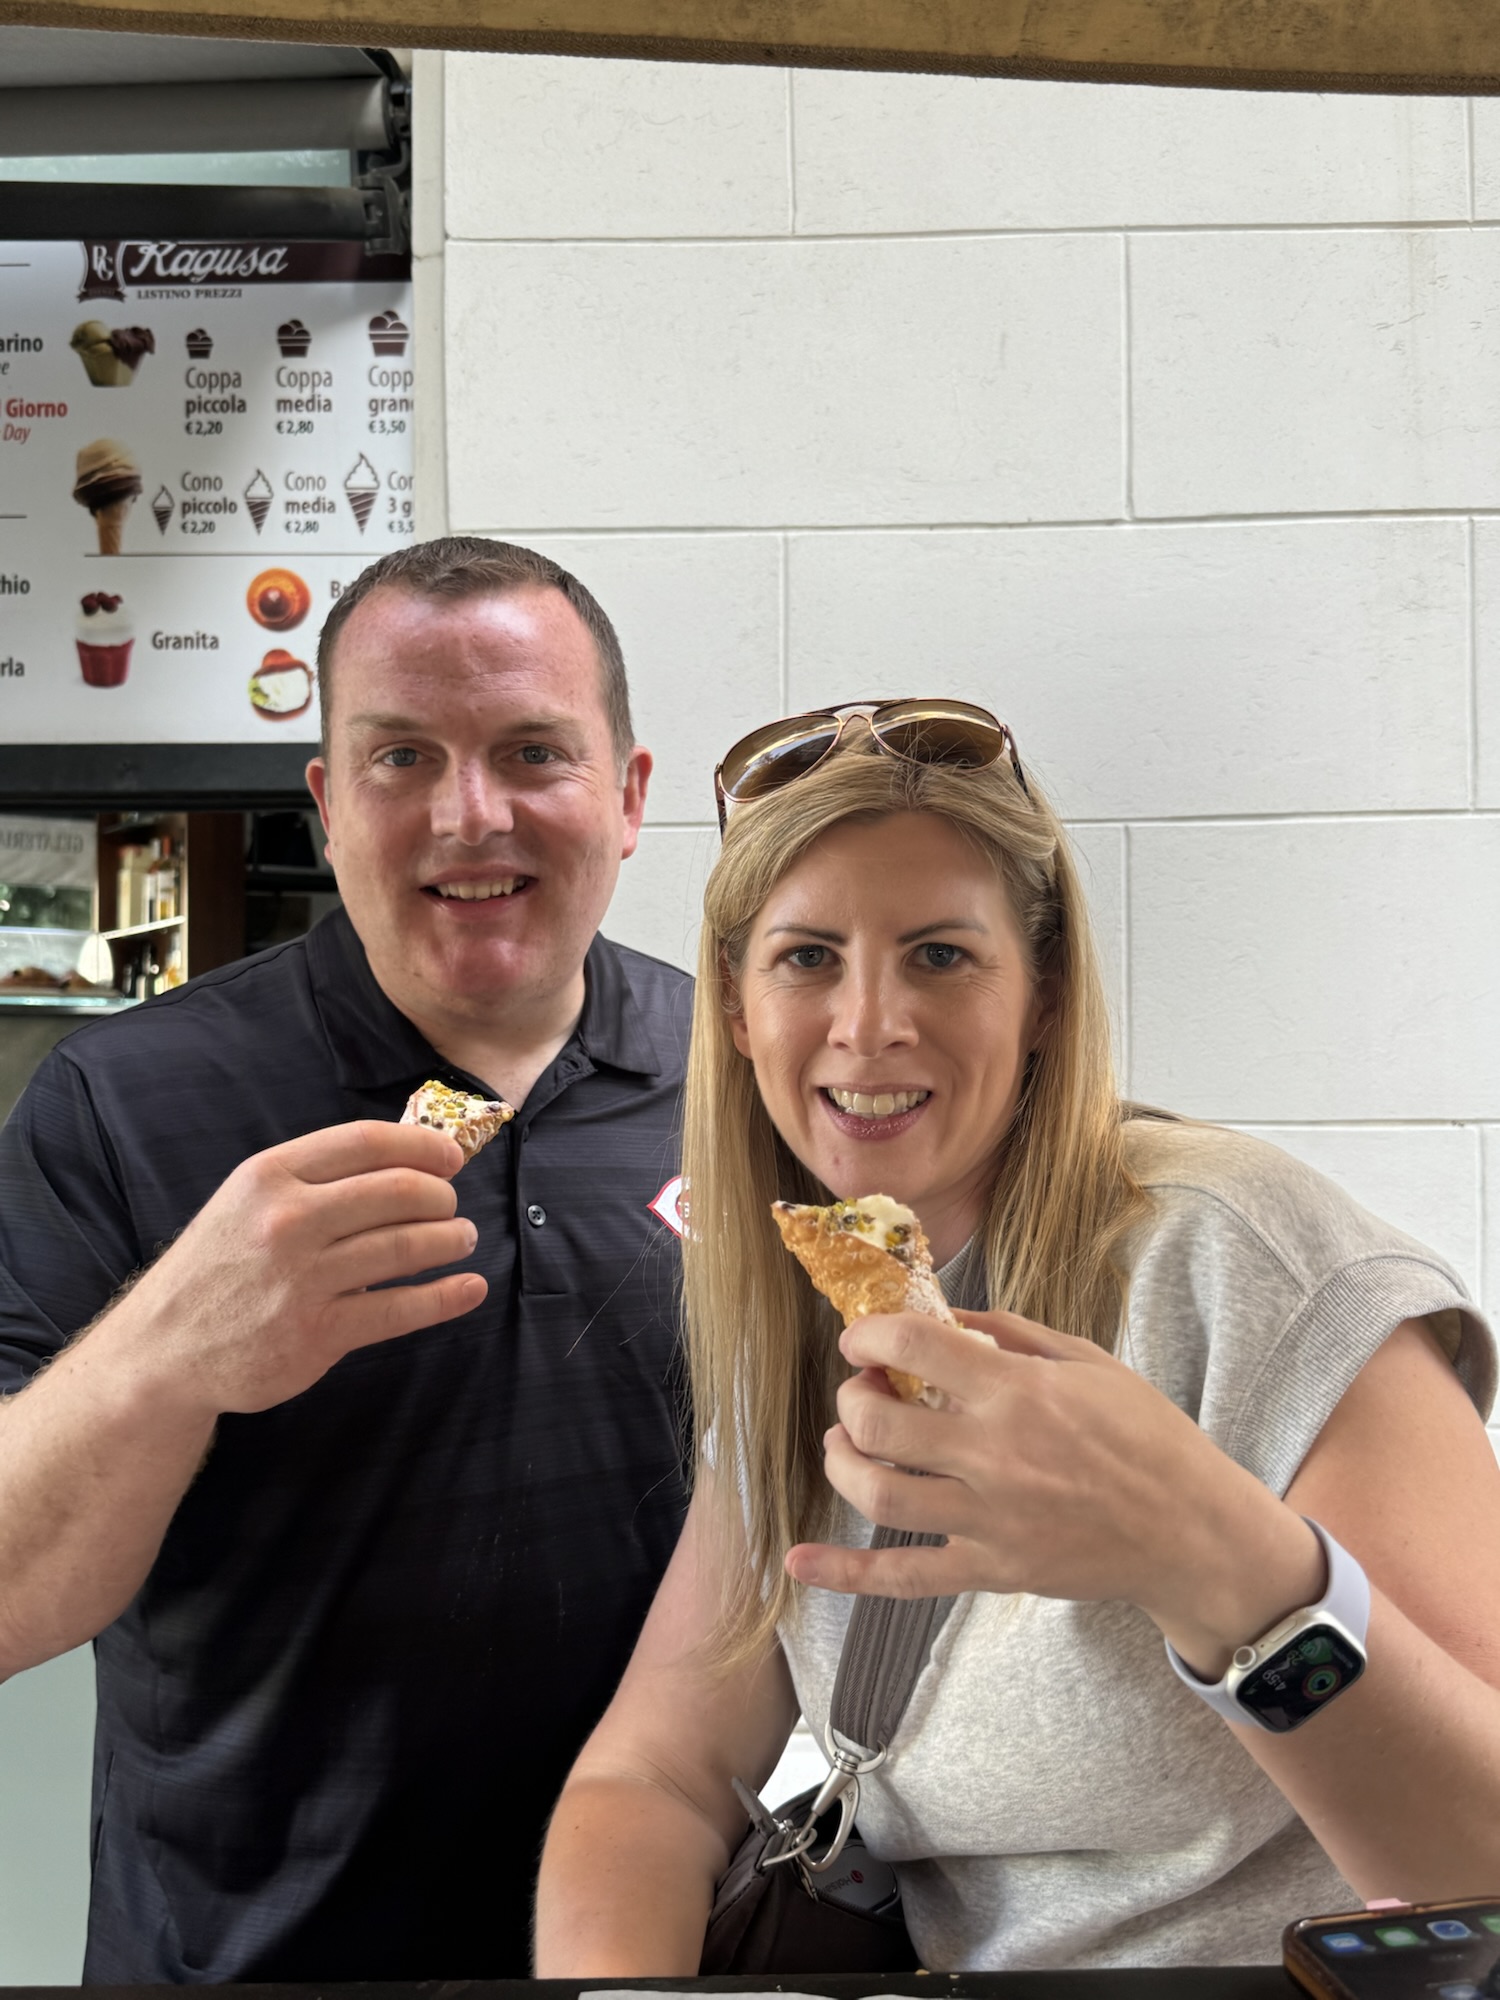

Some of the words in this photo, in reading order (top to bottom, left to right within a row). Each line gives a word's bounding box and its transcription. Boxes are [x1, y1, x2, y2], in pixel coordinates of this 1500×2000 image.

[137, 289, 191, 300] LISTINO
[194, 288, 243, 299] PREZZI
[185, 366, 242, 394] Coppa
[276, 366, 333, 393] Coppa
[6, 398, 68, 418] Giorno
[185, 394, 247, 419] piccola
[276, 394, 332, 413] media
[3, 422, 31, 445] Day
[181, 471, 223, 492] Cono
[285, 471, 327, 491] Cono
[181, 496, 238, 519] piccolo
[285, 496, 336, 514] media
[388, 497, 397, 513] 3
[152, 630, 220, 651] Granita
[1262, 1669, 1287, 1691] 4:59
